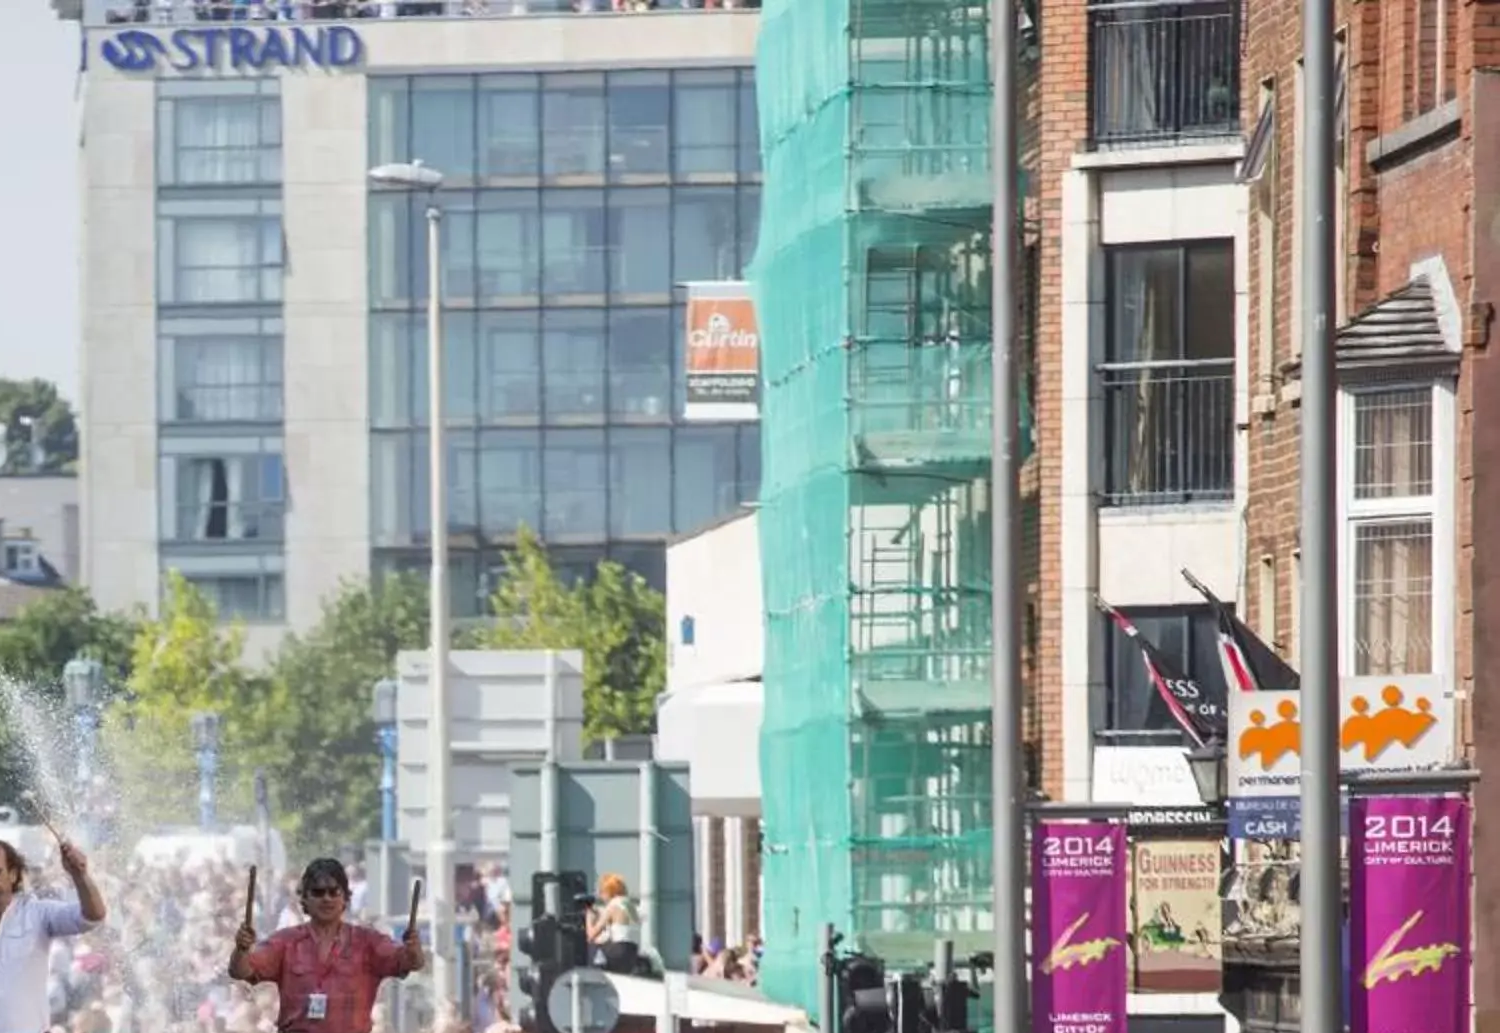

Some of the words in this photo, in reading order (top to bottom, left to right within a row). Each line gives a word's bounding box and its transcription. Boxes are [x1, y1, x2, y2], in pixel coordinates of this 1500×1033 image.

[171, 26, 362, 70] STRAND
[1245, 821, 1287, 836] CASH
[1365, 815, 1455, 839] 2014
[1042, 836, 1115, 856] 2014
[1364, 840, 1454, 853] LIMERICK
[1042, 856, 1114, 868] LIMERICK
[1364, 855, 1389, 865] CITY
[1404, 855, 1453, 865] CULTURE
[1161, 876, 1216, 891] STRENGTH
[1048, 1012, 1112, 1023] LIMERICK
